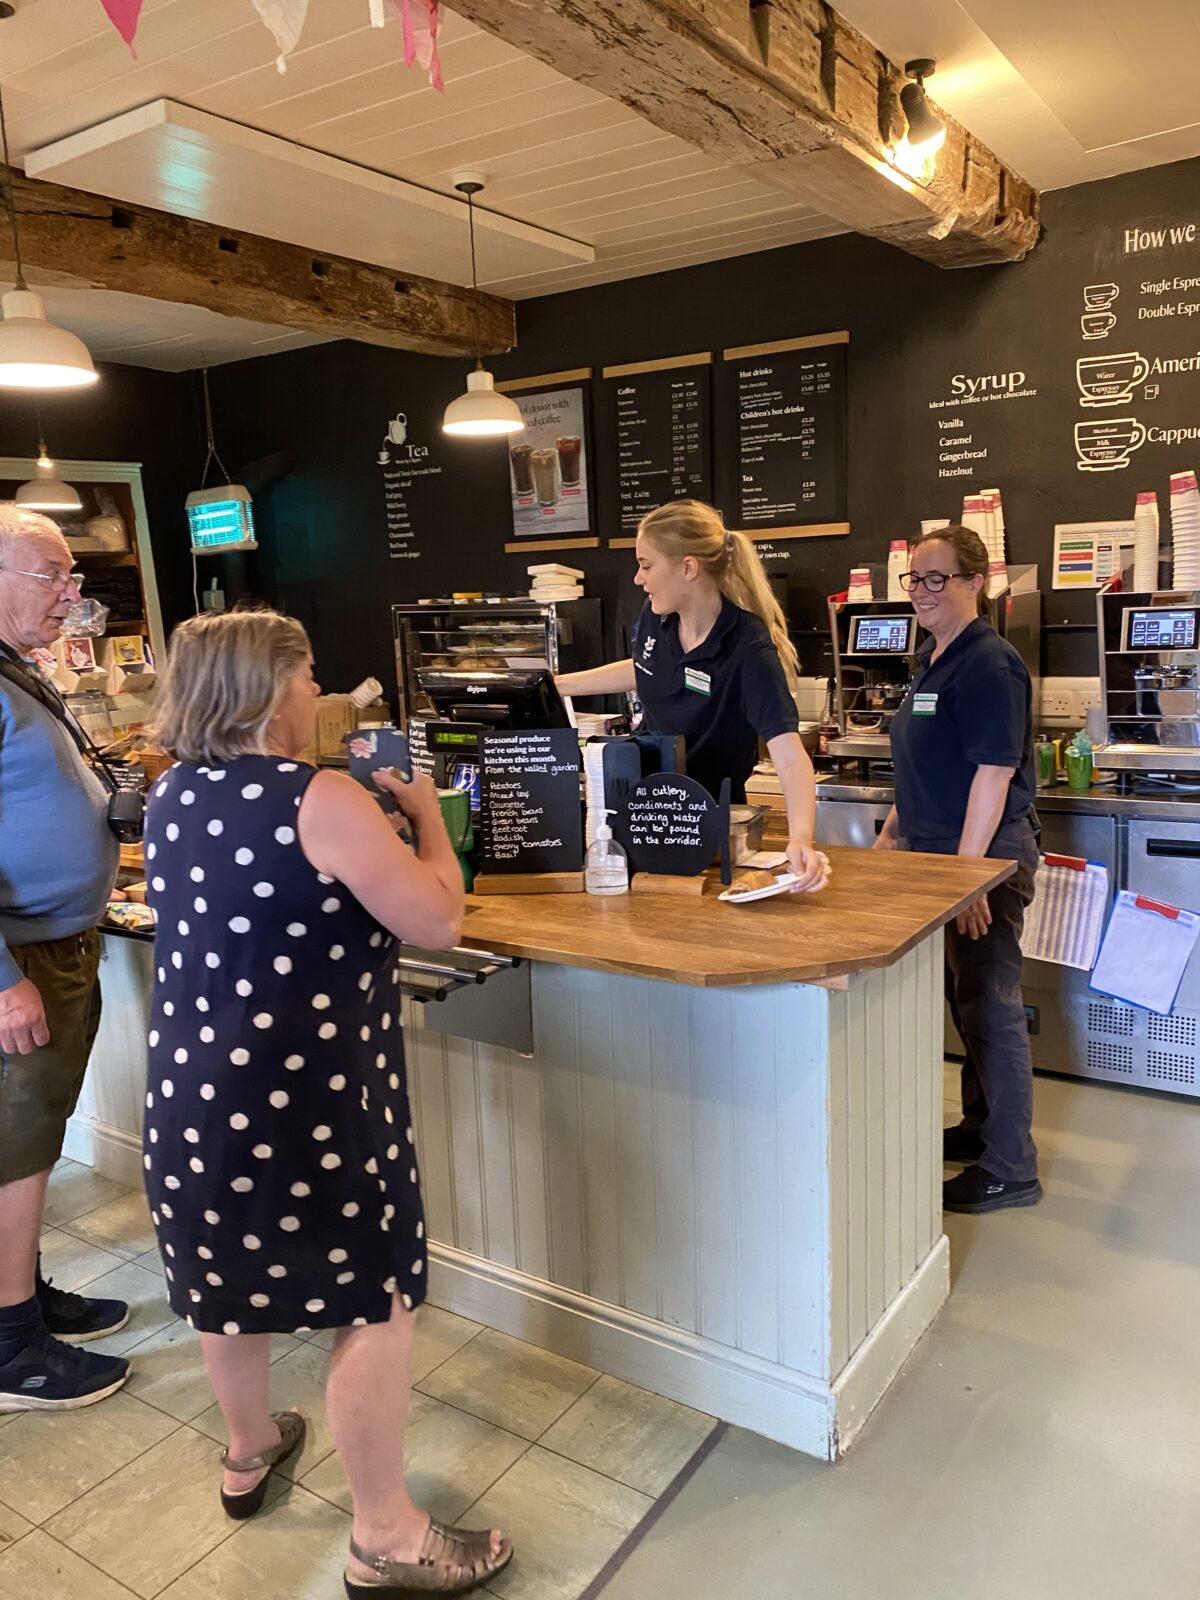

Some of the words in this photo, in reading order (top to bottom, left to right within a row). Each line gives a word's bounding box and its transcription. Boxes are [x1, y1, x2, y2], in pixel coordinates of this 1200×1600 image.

[1124, 228, 1166, 253] How
[1170, 224, 1197, 245] we
[1140, 279, 1171, 295] Single
[1138, 303, 1175, 320] Double
[739, 370, 751, 379] Hot
[752, 367, 773, 376] drinks
[1096, 372, 1116, 380] Water
[951, 371, 1025, 398] Syrup
[1092, 384, 1120, 394] Espresso
[618, 387, 636, 396] Coffee
[945, 398, 960, 406] with
[961, 396, 980, 404] coffee
[990, 393, 1002, 401] hot
[1003, 389, 1038, 399] chocolate
[529, 403, 551, 413] down
[552, 398, 569, 409] with
[740, 410, 771, 420] Children's
[772, 407, 783, 415] hot
[784, 405, 805, 414] drinks
[538, 414, 562, 425] coffee
[938, 418, 964, 429] Vanilla
[939, 434, 972, 447] Caramel
[405, 444, 429, 458] Tea
[939, 448, 987, 463] Gingerbread
[1090, 450, 1117, 458] Espresso
[939, 466, 973, 478] Hazelnut
[742, 474, 753, 482] Tea
[764, 551, 777, 559] own
[778, 551, 791, 560] cup.
[466, 685, 488, 693] digipos
[484, 735, 518, 745] Seasonal
[519, 735, 551, 745] produce
[484, 747, 505, 755] we're
[506, 746, 528, 755] using
[528, 745, 537, 753] in
[484, 756, 514, 764] kitchen
[514, 755, 529, 763] this
[530, 754, 556, 763] month
[524, 764, 548, 773] walled
[551, 762, 578, 776] garden
[489, 781, 522, 791] Potatoes
[636, 787, 647, 796] All
[489, 791, 514, 799] Mixed
[489, 800, 525, 810] Courgette
[688, 800, 708, 812] and
[491, 809, 519, 818] French
[521, 807, 544, 816] beans
[491, 818, 513, 826] Green
[516, 816, 539, 825] beans
[630, 813, 668, 827] drinking
[673, 812, 702, 823] water
[492, 825, 528, 834] Beetroot
[652, 823, 664, 833] be
[669, 824, 700, 835] found
[493, 834, 524, 842] Radish
[521, 838, 562, 848] tomatoes
[632, 835, 642, 845] in
[645, 836, 659, 845] the
[663, 834, 703, 847] corridor.
